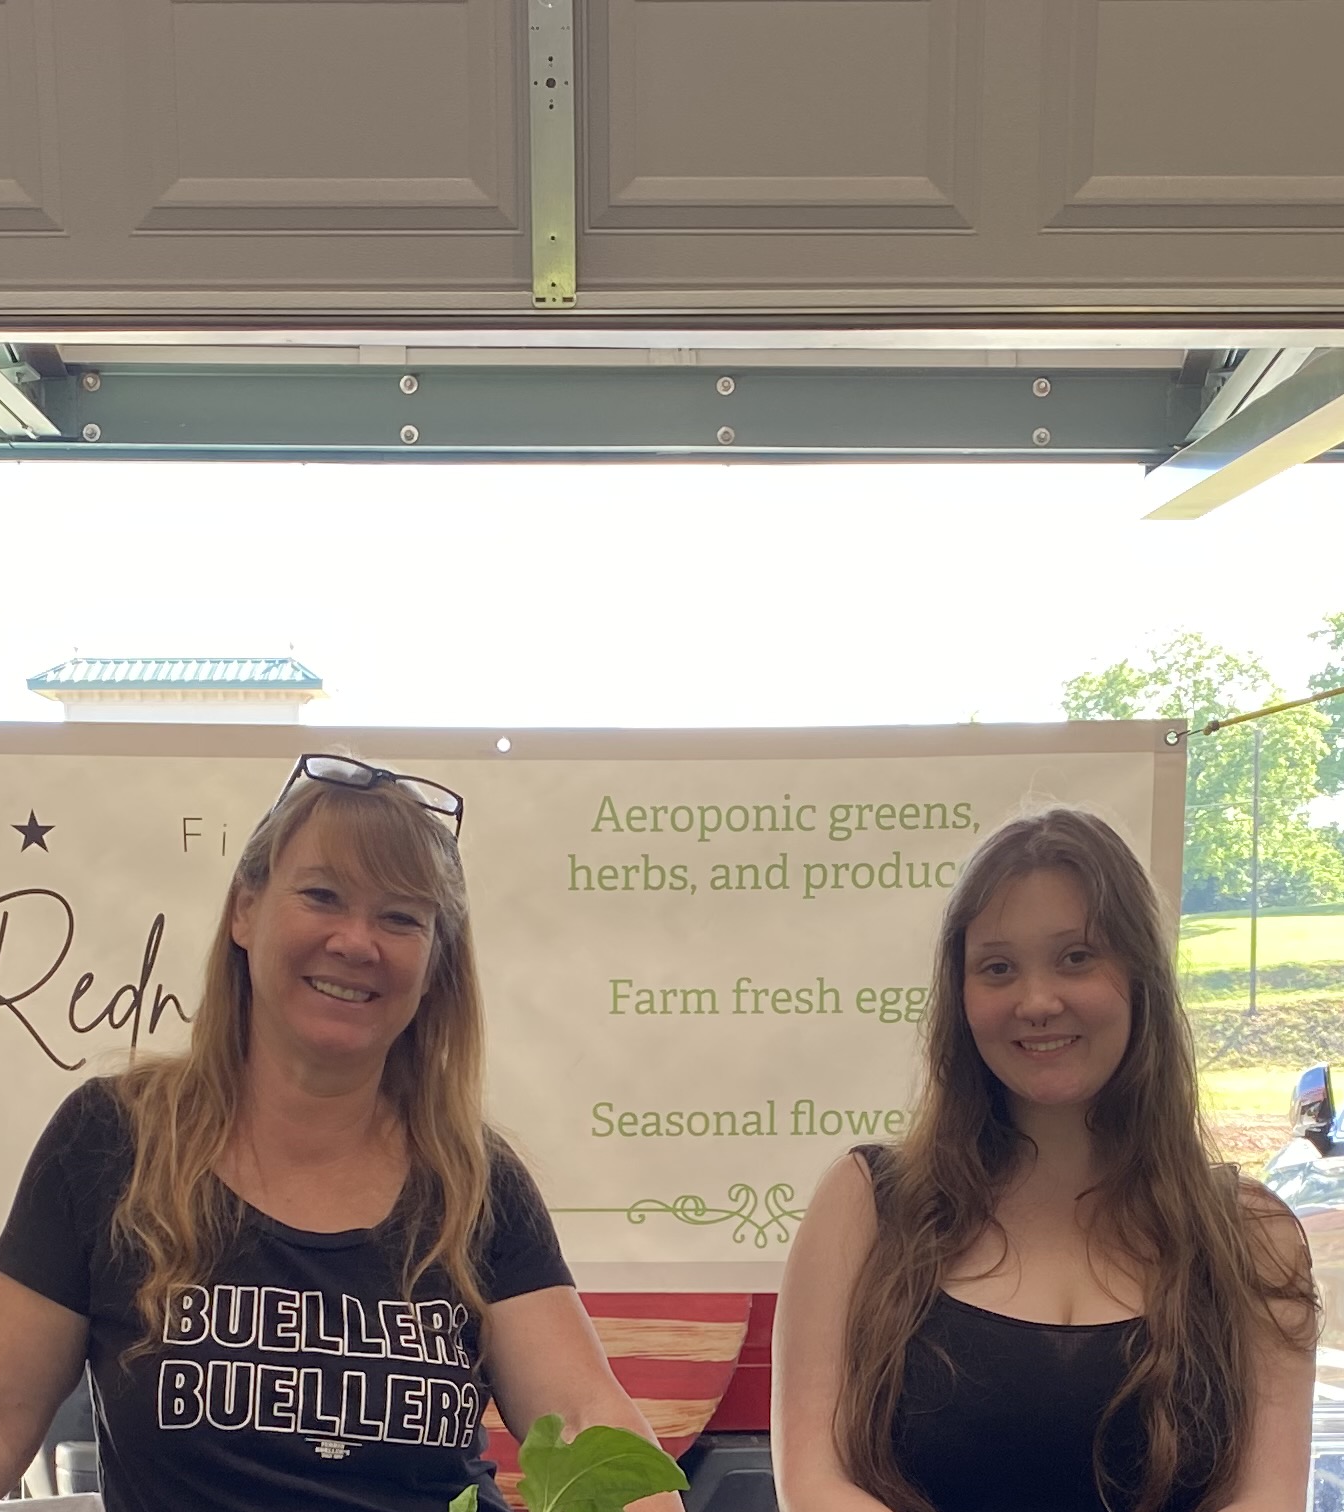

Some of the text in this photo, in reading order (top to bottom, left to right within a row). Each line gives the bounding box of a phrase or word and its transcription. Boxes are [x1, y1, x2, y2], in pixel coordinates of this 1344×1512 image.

[591, 794, 981, 842] Aeroponic greens,
[567, 854, 698, 896] herbs,
[710, 853, 790, 892] and
[609, 979, 719, 1015] Farm
[732, 977, 844, 1014] fresh
[591, 1099, 914, 1137] Seasonal flowe
[157, 1359, 480, 1449] BUELLER?
